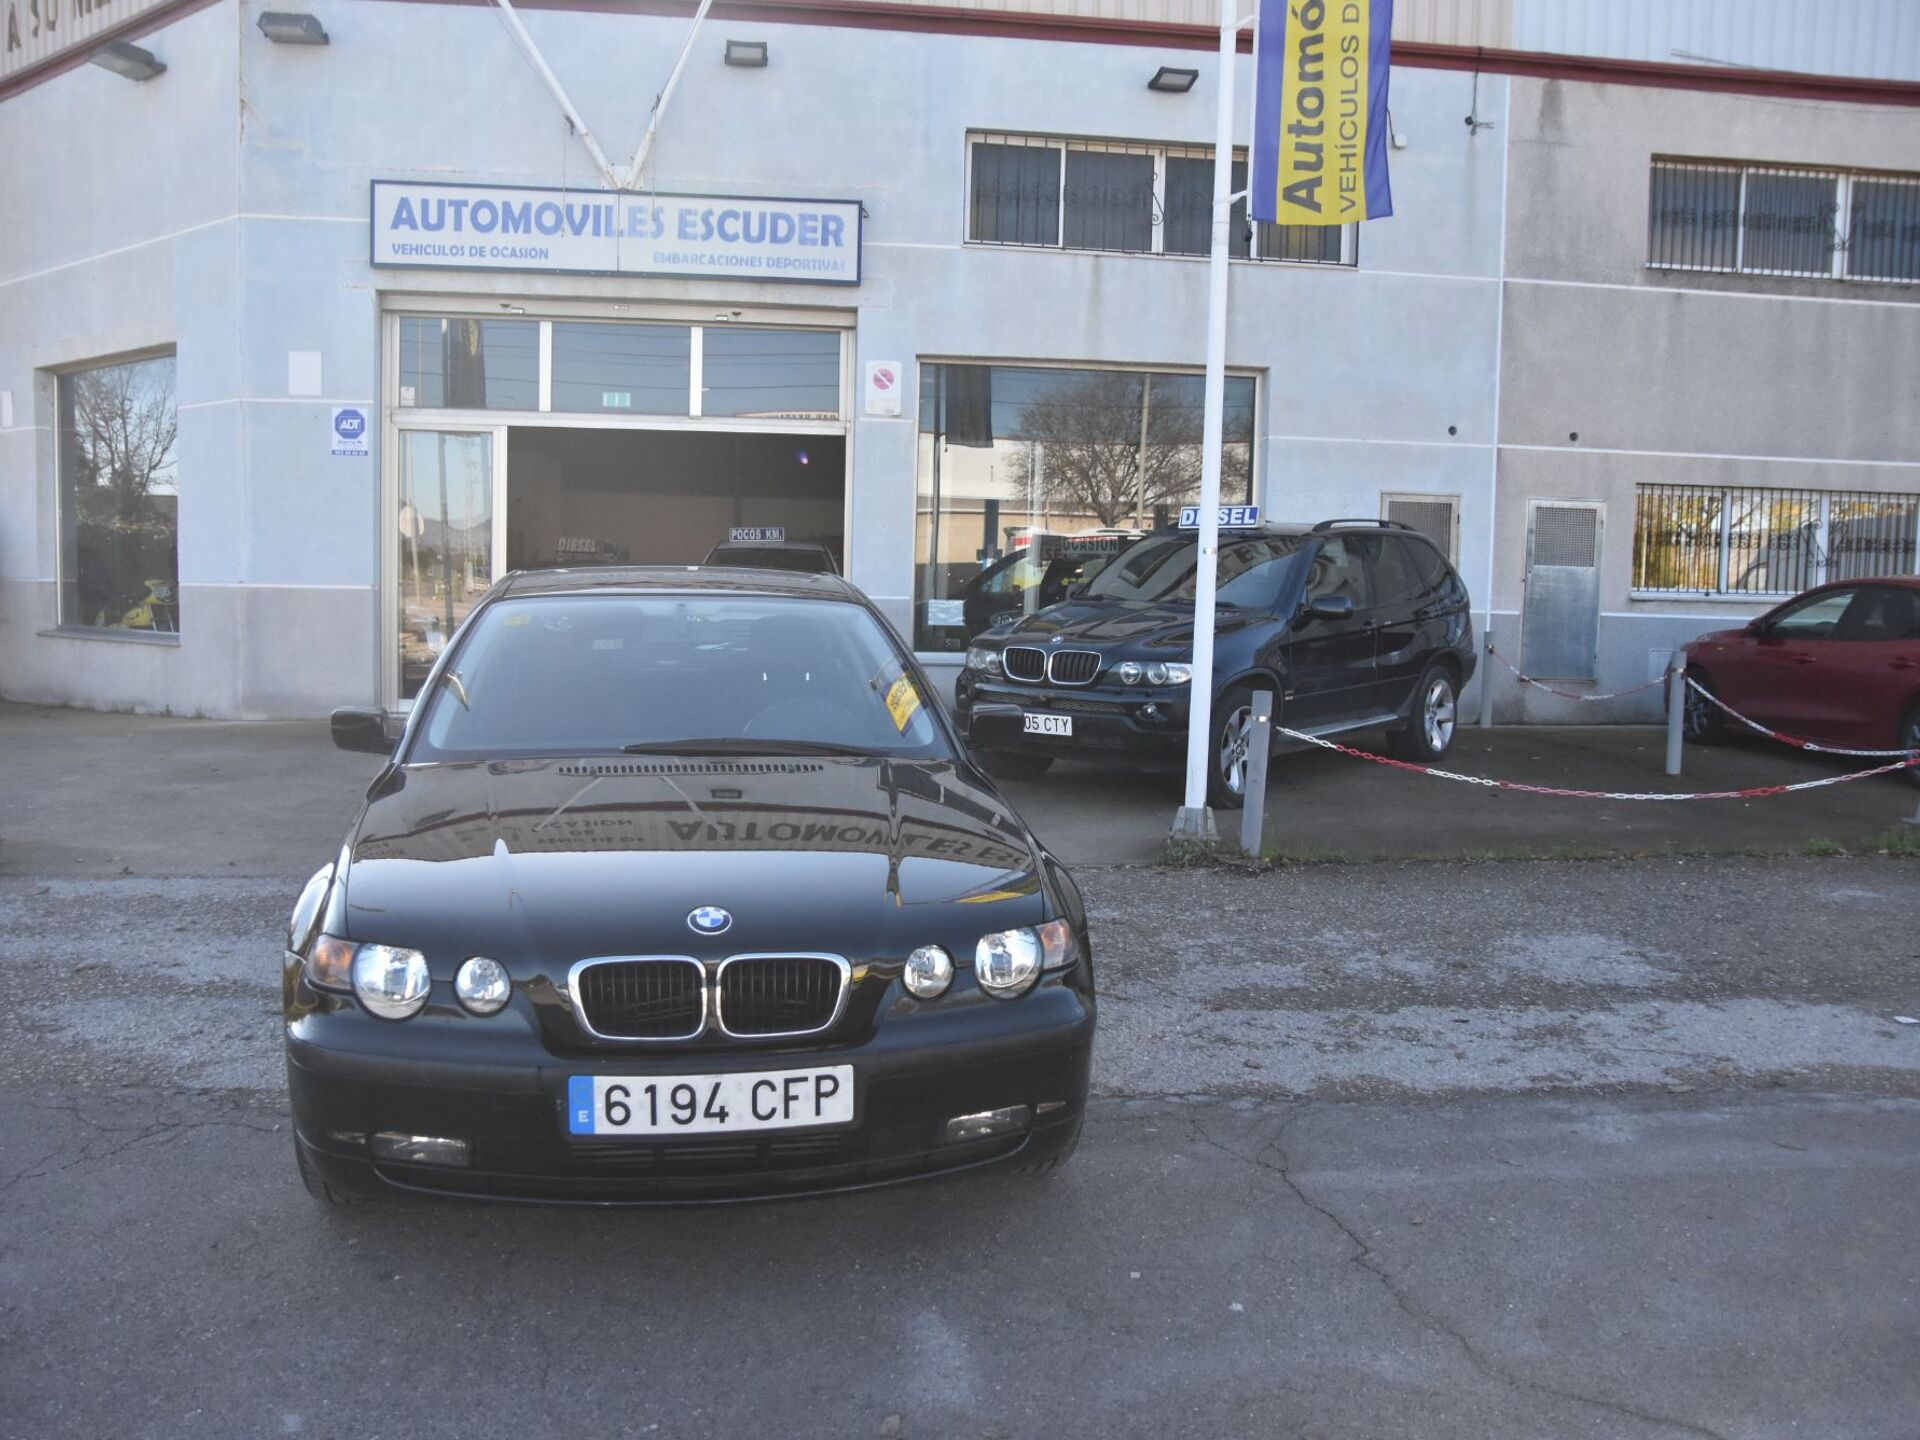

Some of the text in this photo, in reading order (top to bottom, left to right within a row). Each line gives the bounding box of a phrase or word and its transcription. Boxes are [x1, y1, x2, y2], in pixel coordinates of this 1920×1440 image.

[1283, 0, 1326, 214] Automó
[1335, 0, 1361, 213] VEHÍCULOS D
[391, 196, 845, 247] AUTOMOVILES ESCUDER
[392, 243, 549, 260] VEHICULOS DE OCASION
[653, 252, 763, 268] EMBARCACIONES
[340, 418, 361, 430] ADT
[1181, 508, 1256, 526] DISEL
[731, 529, 761, 540] POCOS
[1044, 717, 1069, 733] CTY
[604, 1073, 841, 1127] 6194 CFP
[578, 1110, 589, 1123] E
